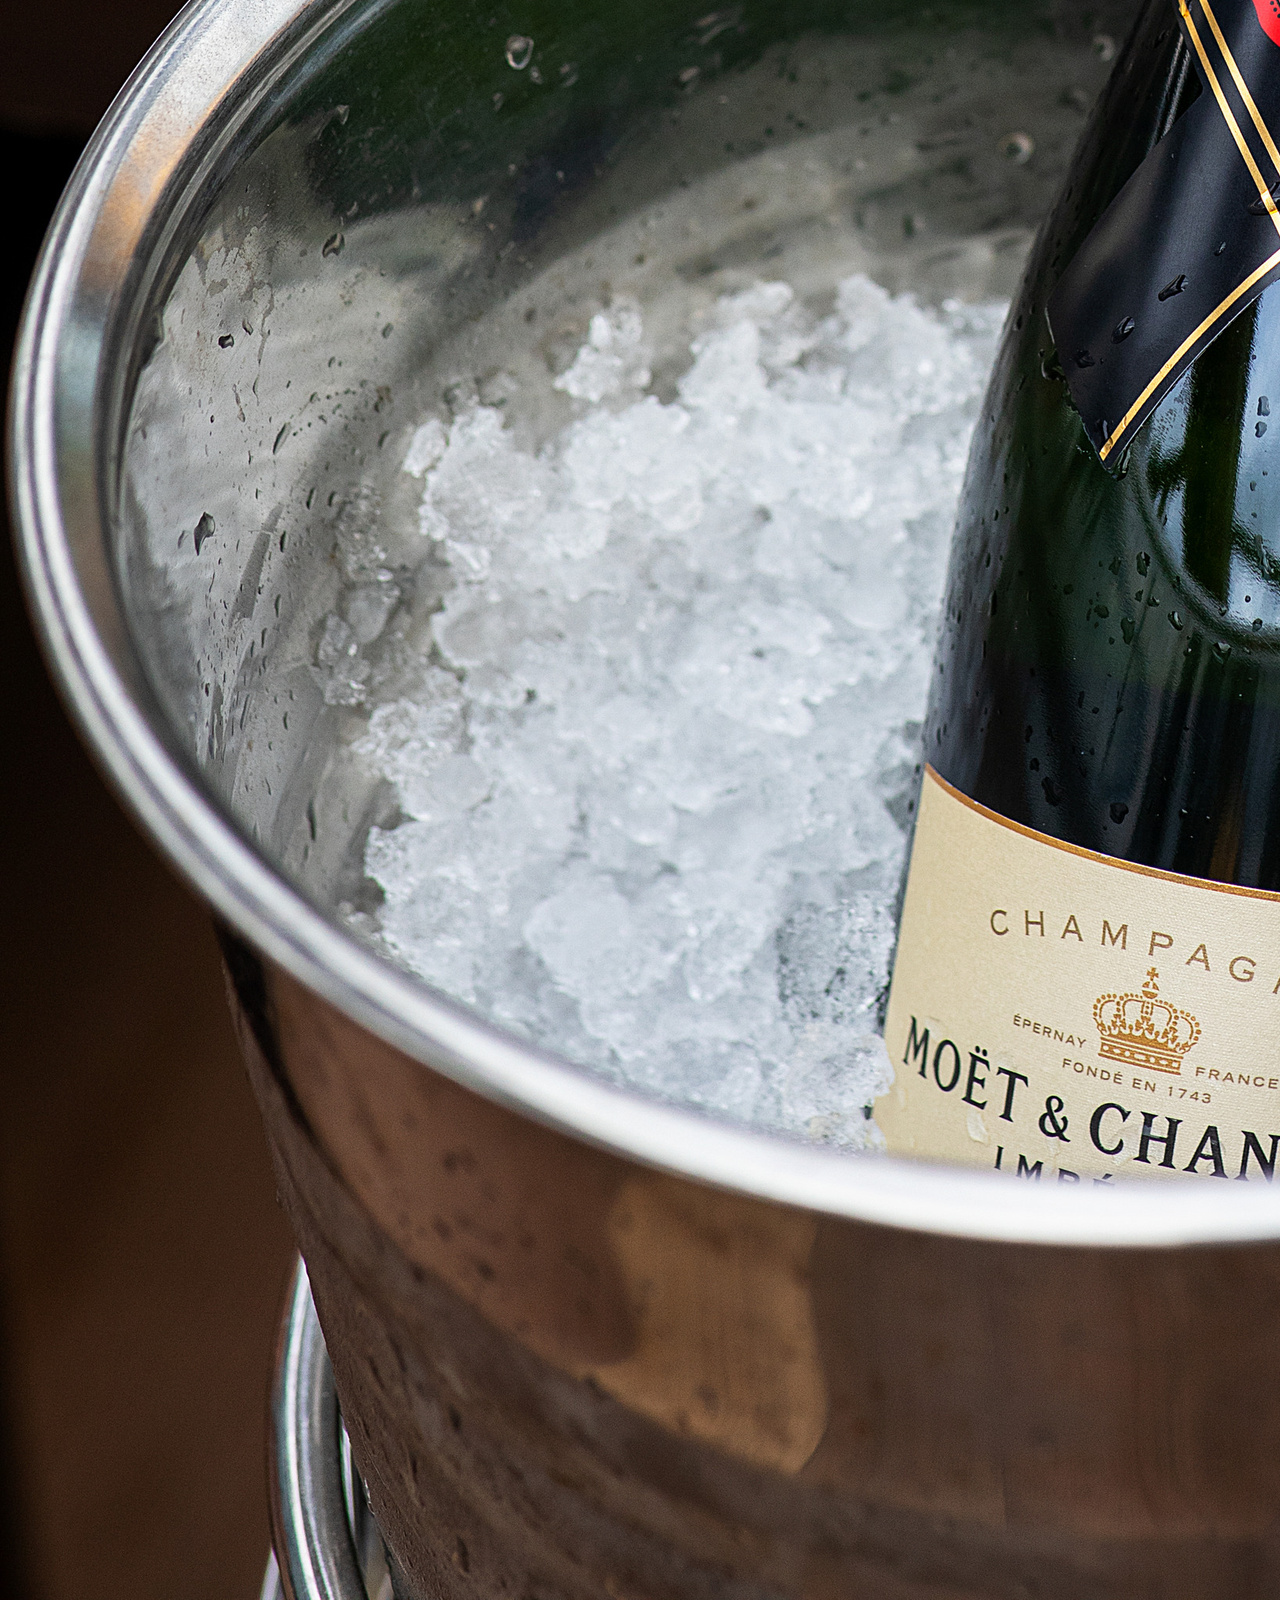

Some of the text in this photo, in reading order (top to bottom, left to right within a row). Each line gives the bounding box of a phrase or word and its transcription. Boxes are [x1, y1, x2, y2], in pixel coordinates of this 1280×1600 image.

[902, 1015, 1029, 1123] MOËT
[1038, 1095, 1072, 1143] &
[1012, 1013, 1280, 1090] ÉPERNAY FRANCE
[1061, 1057, 1213, 1105] FONDÉ EN 1743
